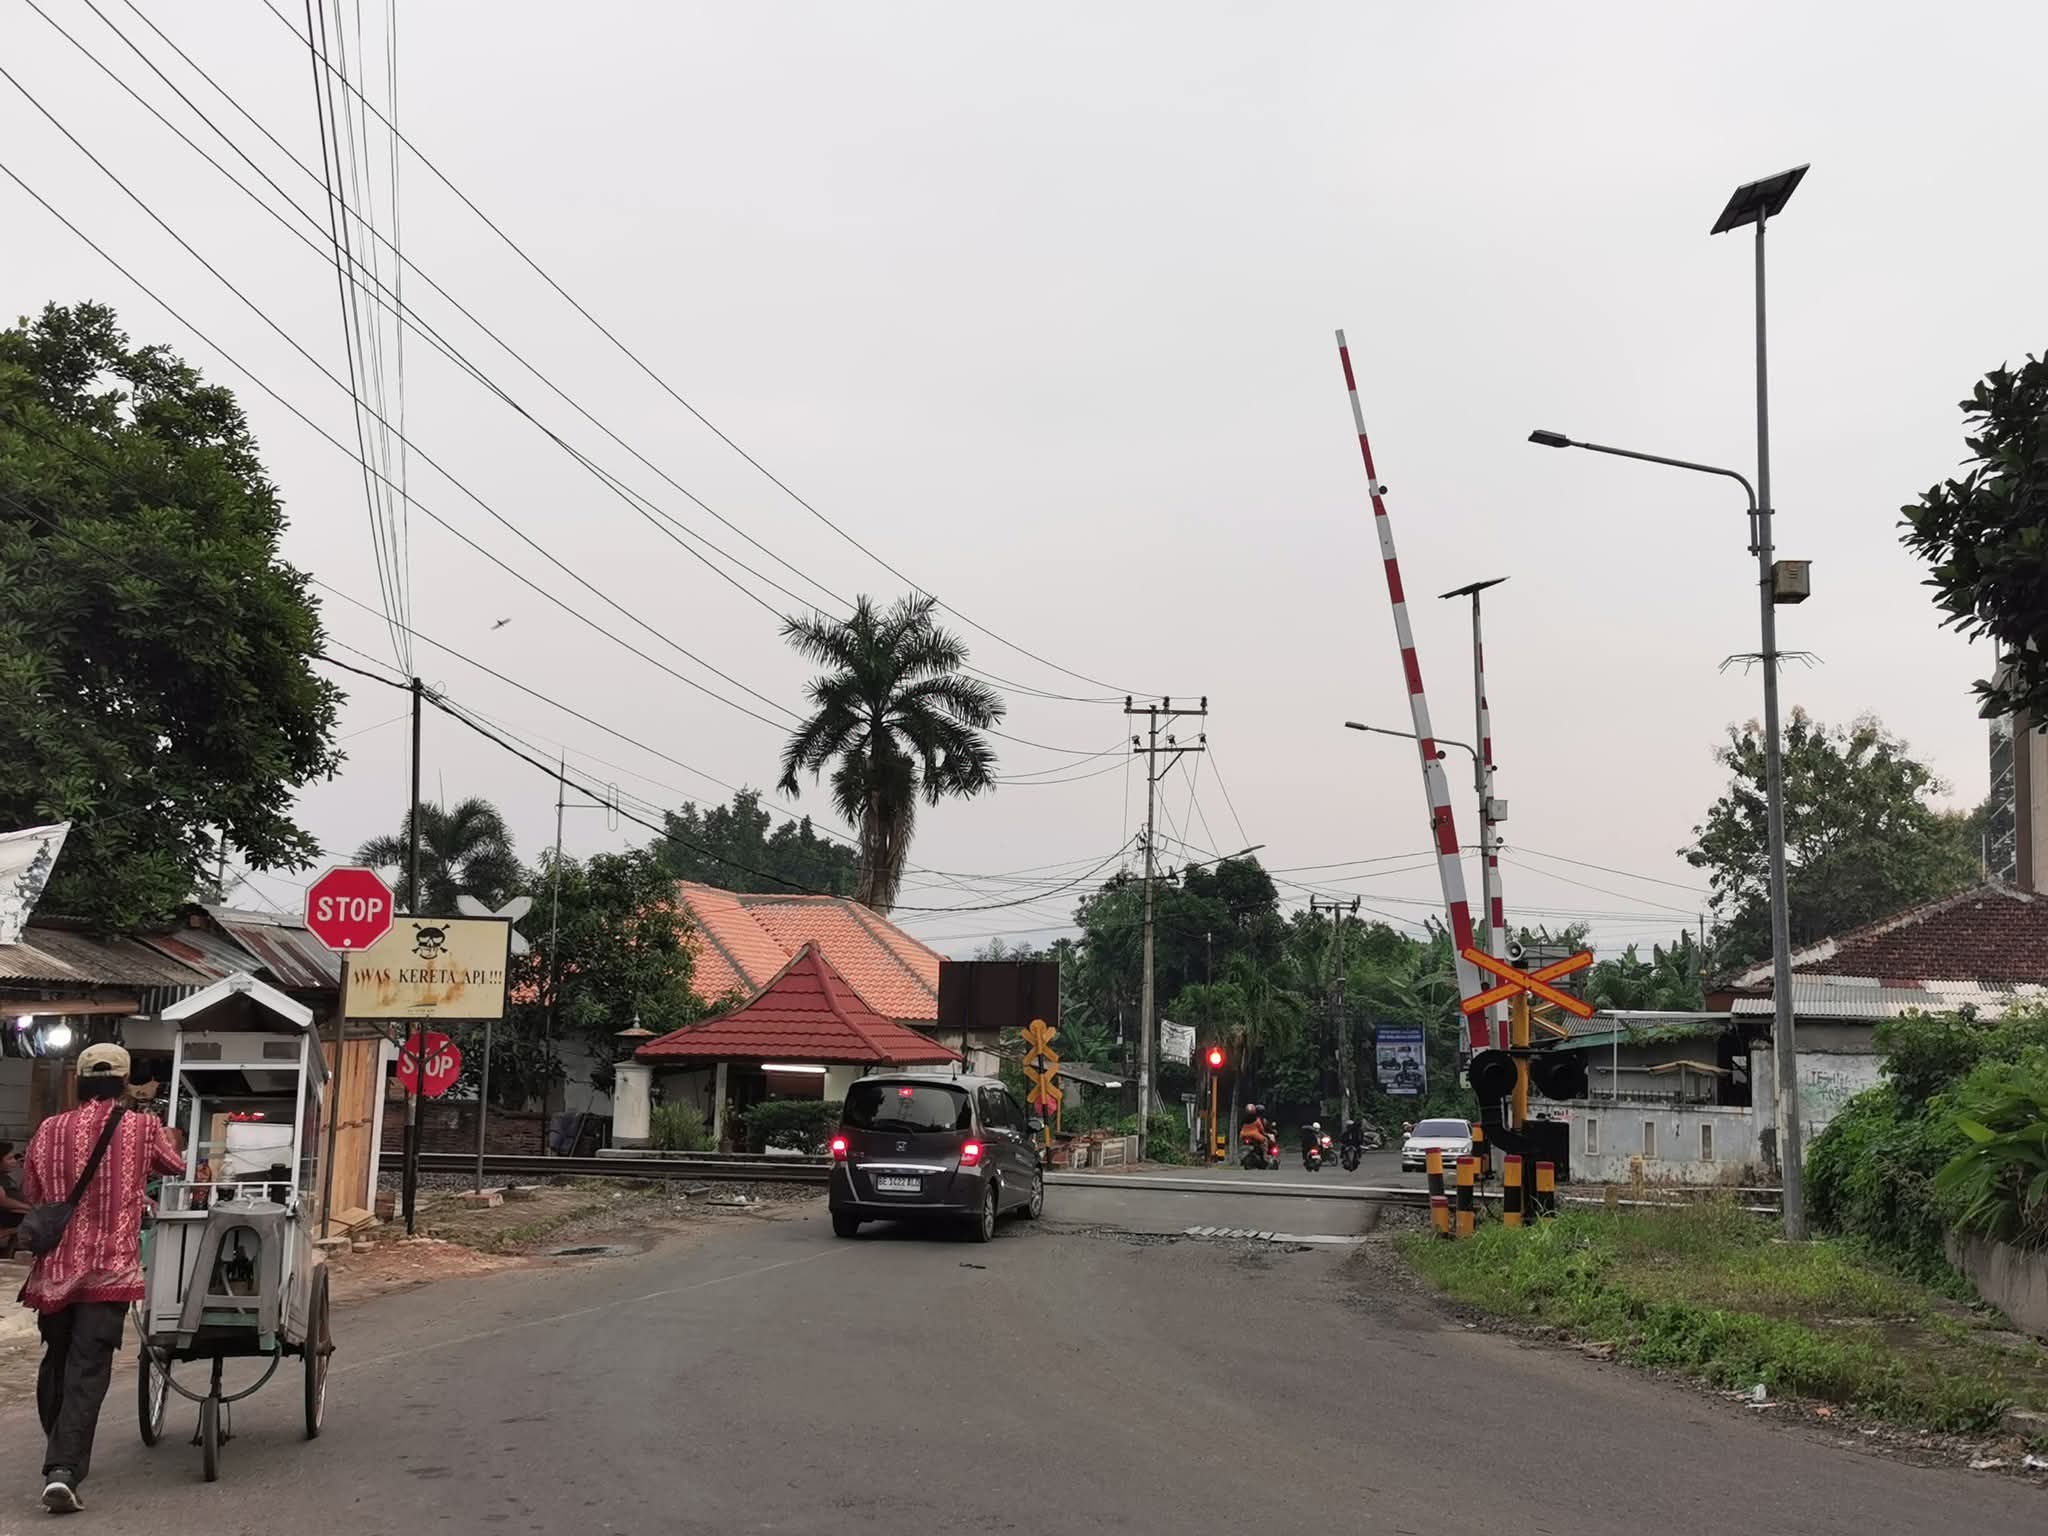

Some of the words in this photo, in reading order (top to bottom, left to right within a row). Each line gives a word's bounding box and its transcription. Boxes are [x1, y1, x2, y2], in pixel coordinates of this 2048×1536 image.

[316, 896, 384, 923] STOP
[353, 968, 391, 984] AWAS
[399, 968, 456, 984] KERETA
[401, 1050, 454, 1078] SOP
